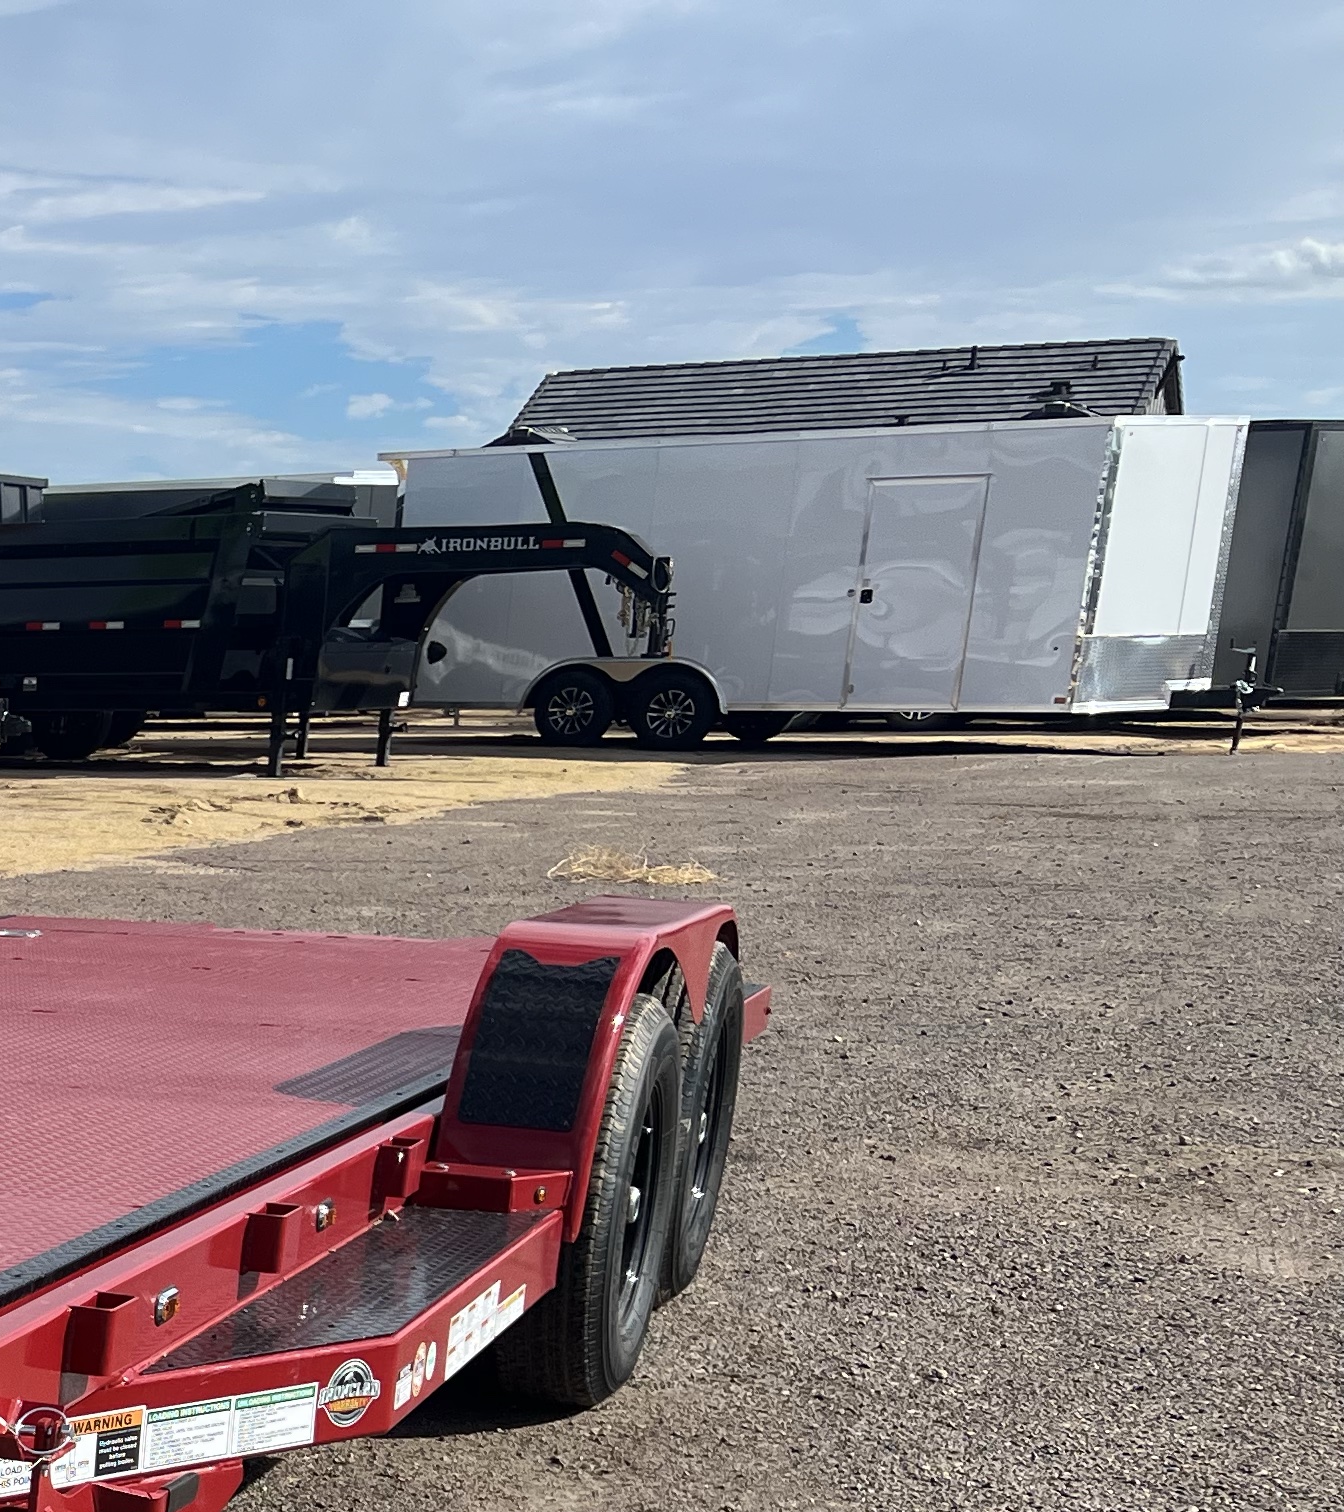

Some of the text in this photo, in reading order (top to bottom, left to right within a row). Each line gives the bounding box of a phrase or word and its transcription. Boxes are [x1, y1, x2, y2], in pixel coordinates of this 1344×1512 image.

[440, 536, 540, 552] IRONBULL
[148, 1410, 180, 1422] LOADING
[74, 1414, 133, 1434] WARNING
[0, 1466, 23, 1477] LOAD
[13, 1476, 31, 1486] POIN
